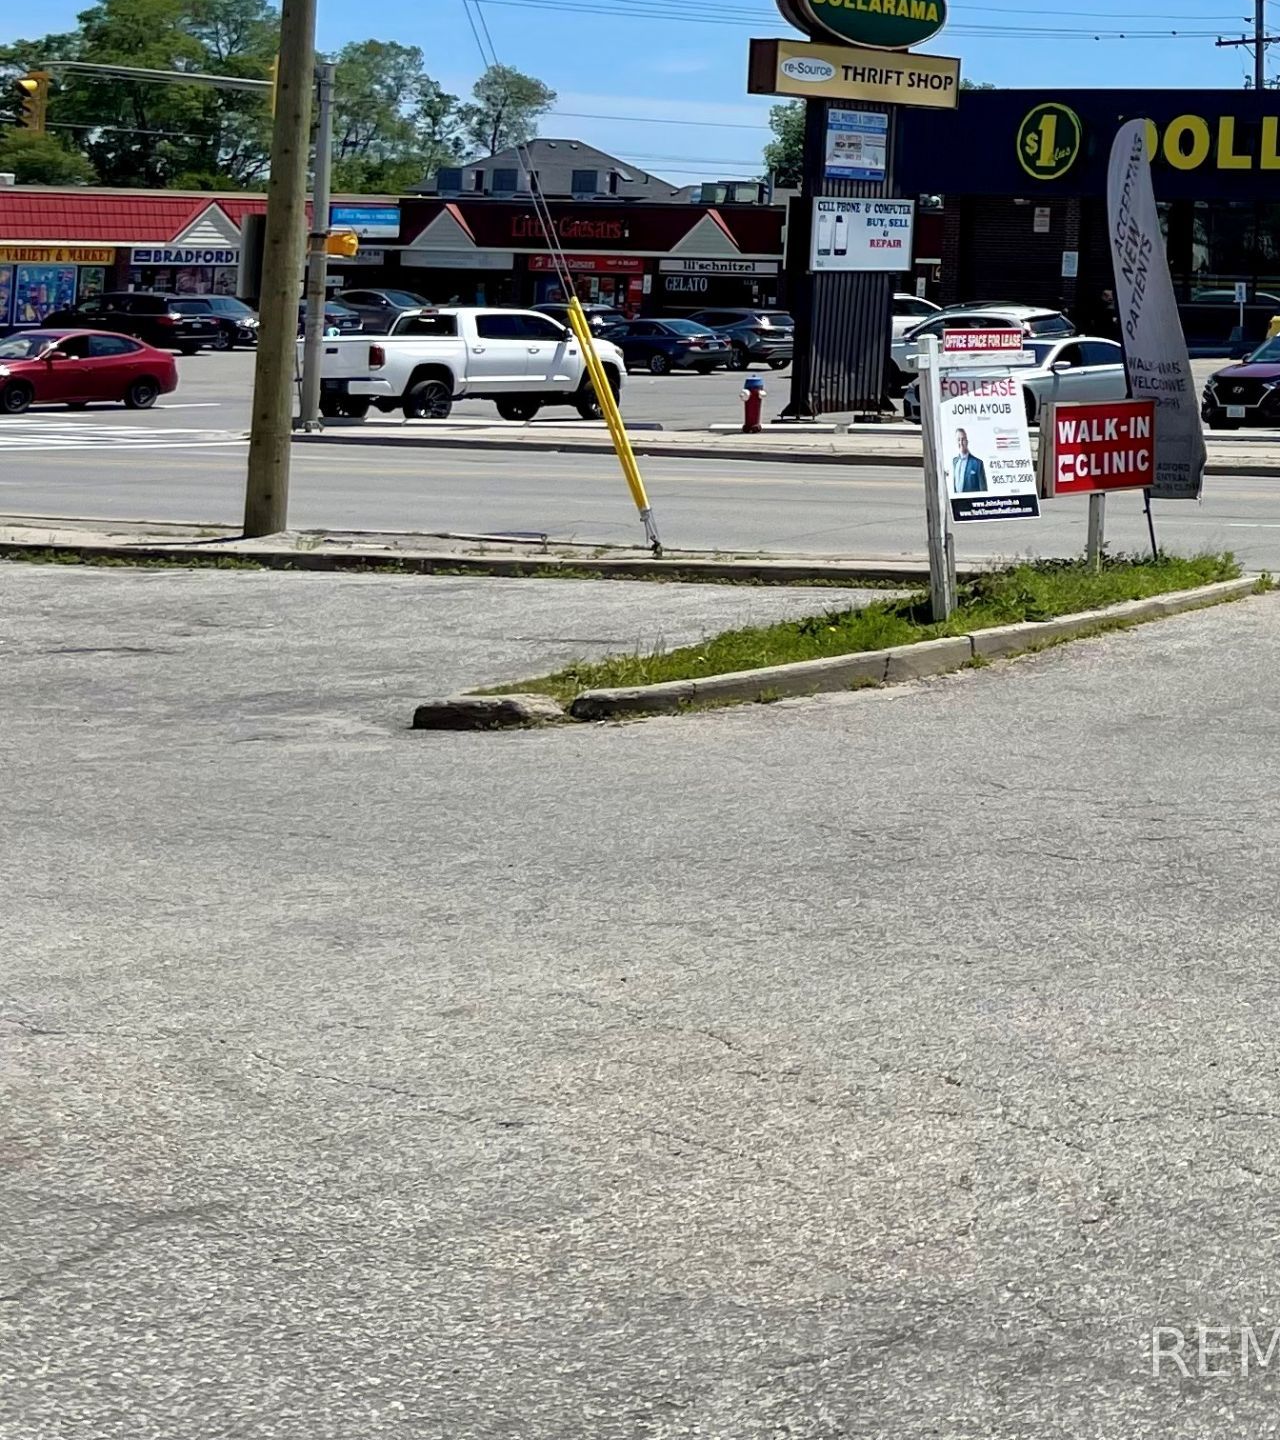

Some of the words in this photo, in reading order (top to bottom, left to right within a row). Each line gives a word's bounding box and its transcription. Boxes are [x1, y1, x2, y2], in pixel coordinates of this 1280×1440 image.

[784, 62, 833, 77] re-Source
[842, 65, 904, 86] THRIFT
[907, 71, 954, 91] SHOP
[1115, 133, 1143, 257] ACCEPTING
[818, 201, 835, 212] CELL
[837, 202, 861, 213] PHONE
[866, 218, 887, 228] BUY,
[889, 219, 909, 227] SELL
[870, 239, 902, 248] REPAIR
[6, 248, 51, 262] VARIETY
[69, 249, 112, 263] MARKET
[153, 249, 233, 263] BRADFORD
[1121, 217, 1141, 286] NEW
[683, 260, 756, 272] lil'schnitzel
[665, 277, 708, 292] GELATO
[1126, 234, 1153, 341] PATIENTS
[945, 335, 967, 348] OFFICE
[969, 335, 987, 348] SPACE
[988, 334, 1000, 347] FOR
[1001, 333, 1021, 347] LEASE
[941, 379, 969, 397] FOR
[974, 377, 1017, 396] LEASE
[952, 404, 977, 415] JOHN
[980, 404, 1012, 415] AYOUB
[1058, 416, 1150, 445] WALK-IN
[1075, 449, 1149, 477] CLINIC
[1157, 463, 1190, 472] ADFORD
[1157, 473, 1189, 482] ENTRAL
